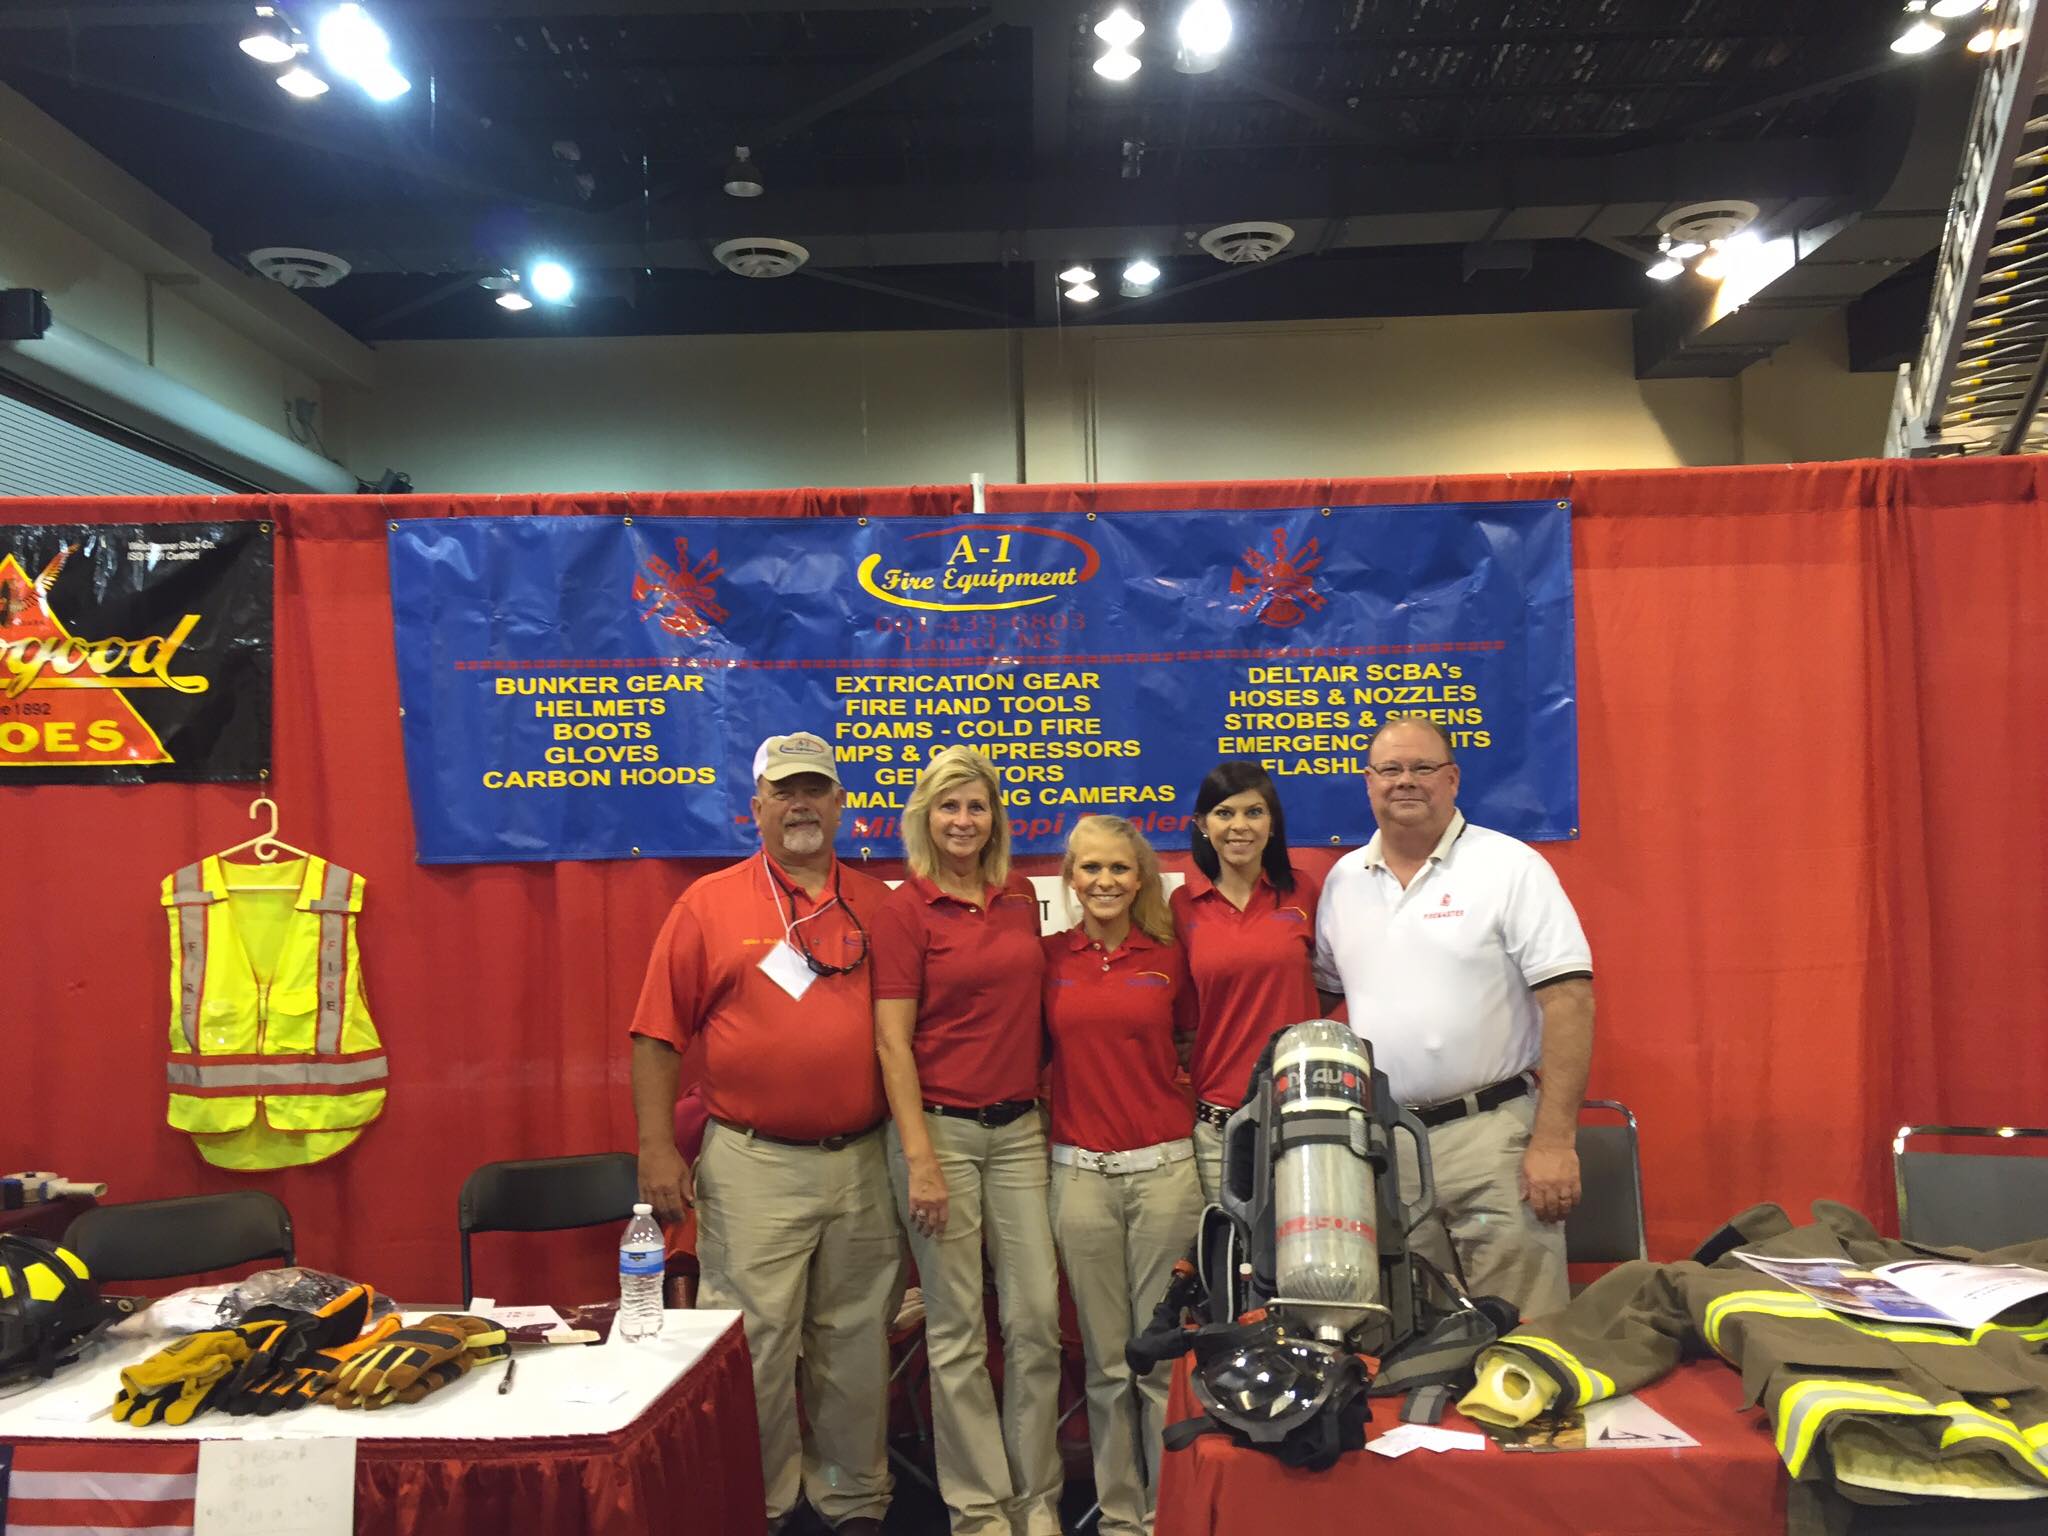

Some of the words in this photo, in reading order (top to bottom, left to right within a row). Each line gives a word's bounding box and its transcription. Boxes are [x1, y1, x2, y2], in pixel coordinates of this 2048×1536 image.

[946, 534, 1011, 565] A-1
[880, 568, 936, 591] Fire
[943, 566, 1078, 594] Equipment
[1017, 630, 1060, 649] MS
[0, 613, 209, 698] good
[835, 673, 1014, 693] EXTRICATION
[1023, 672, 1100, 690] GEAR
[1248, 665, 1359, 684] DELTAIR
[1366, 662, 1463, 682] SCBA's
[495, 676, 618, 695] BUNKER
[626, 674, 704, 692] GEAR
[846, 698, 906, 716] FIRE
[915, 696, 991, 715] HAND
[999, 694, 1092, 713] TOOLS
[1229, 689, 1320, 707] HOSES
[1327, 688, 1346, 706] &
[1353, 685, 1477, 704] NOZZLES
[535, 697, 666, 718] HELMETS
[553, 721, 652, 741] BOOTS
[835, 721, 934, 740] FOAMS
[957, 719, 1033, 739] COLD
[1040, 717, 1101, 736] FIRE
[1224, 711, 1351, 731] STROBES
[1358, 710, 1377, 728] &
[0, 719, 126, 753] OES
[1217, 733, 1375, 754] EMERGENC
[544, 744, 660, 765] GLOVES
[835, 744, 894, 763] MPS
[901, 745, 921, 763] &
[928, 739, 1141, 764] CMPRESSORS
[1261, 757, 1366, 775] FLASHL
[482, 769, 611, 789] CARBON
[620, 767, 716, 786] HOODS
[1039, 784, 1176, 806] CAMERAS
